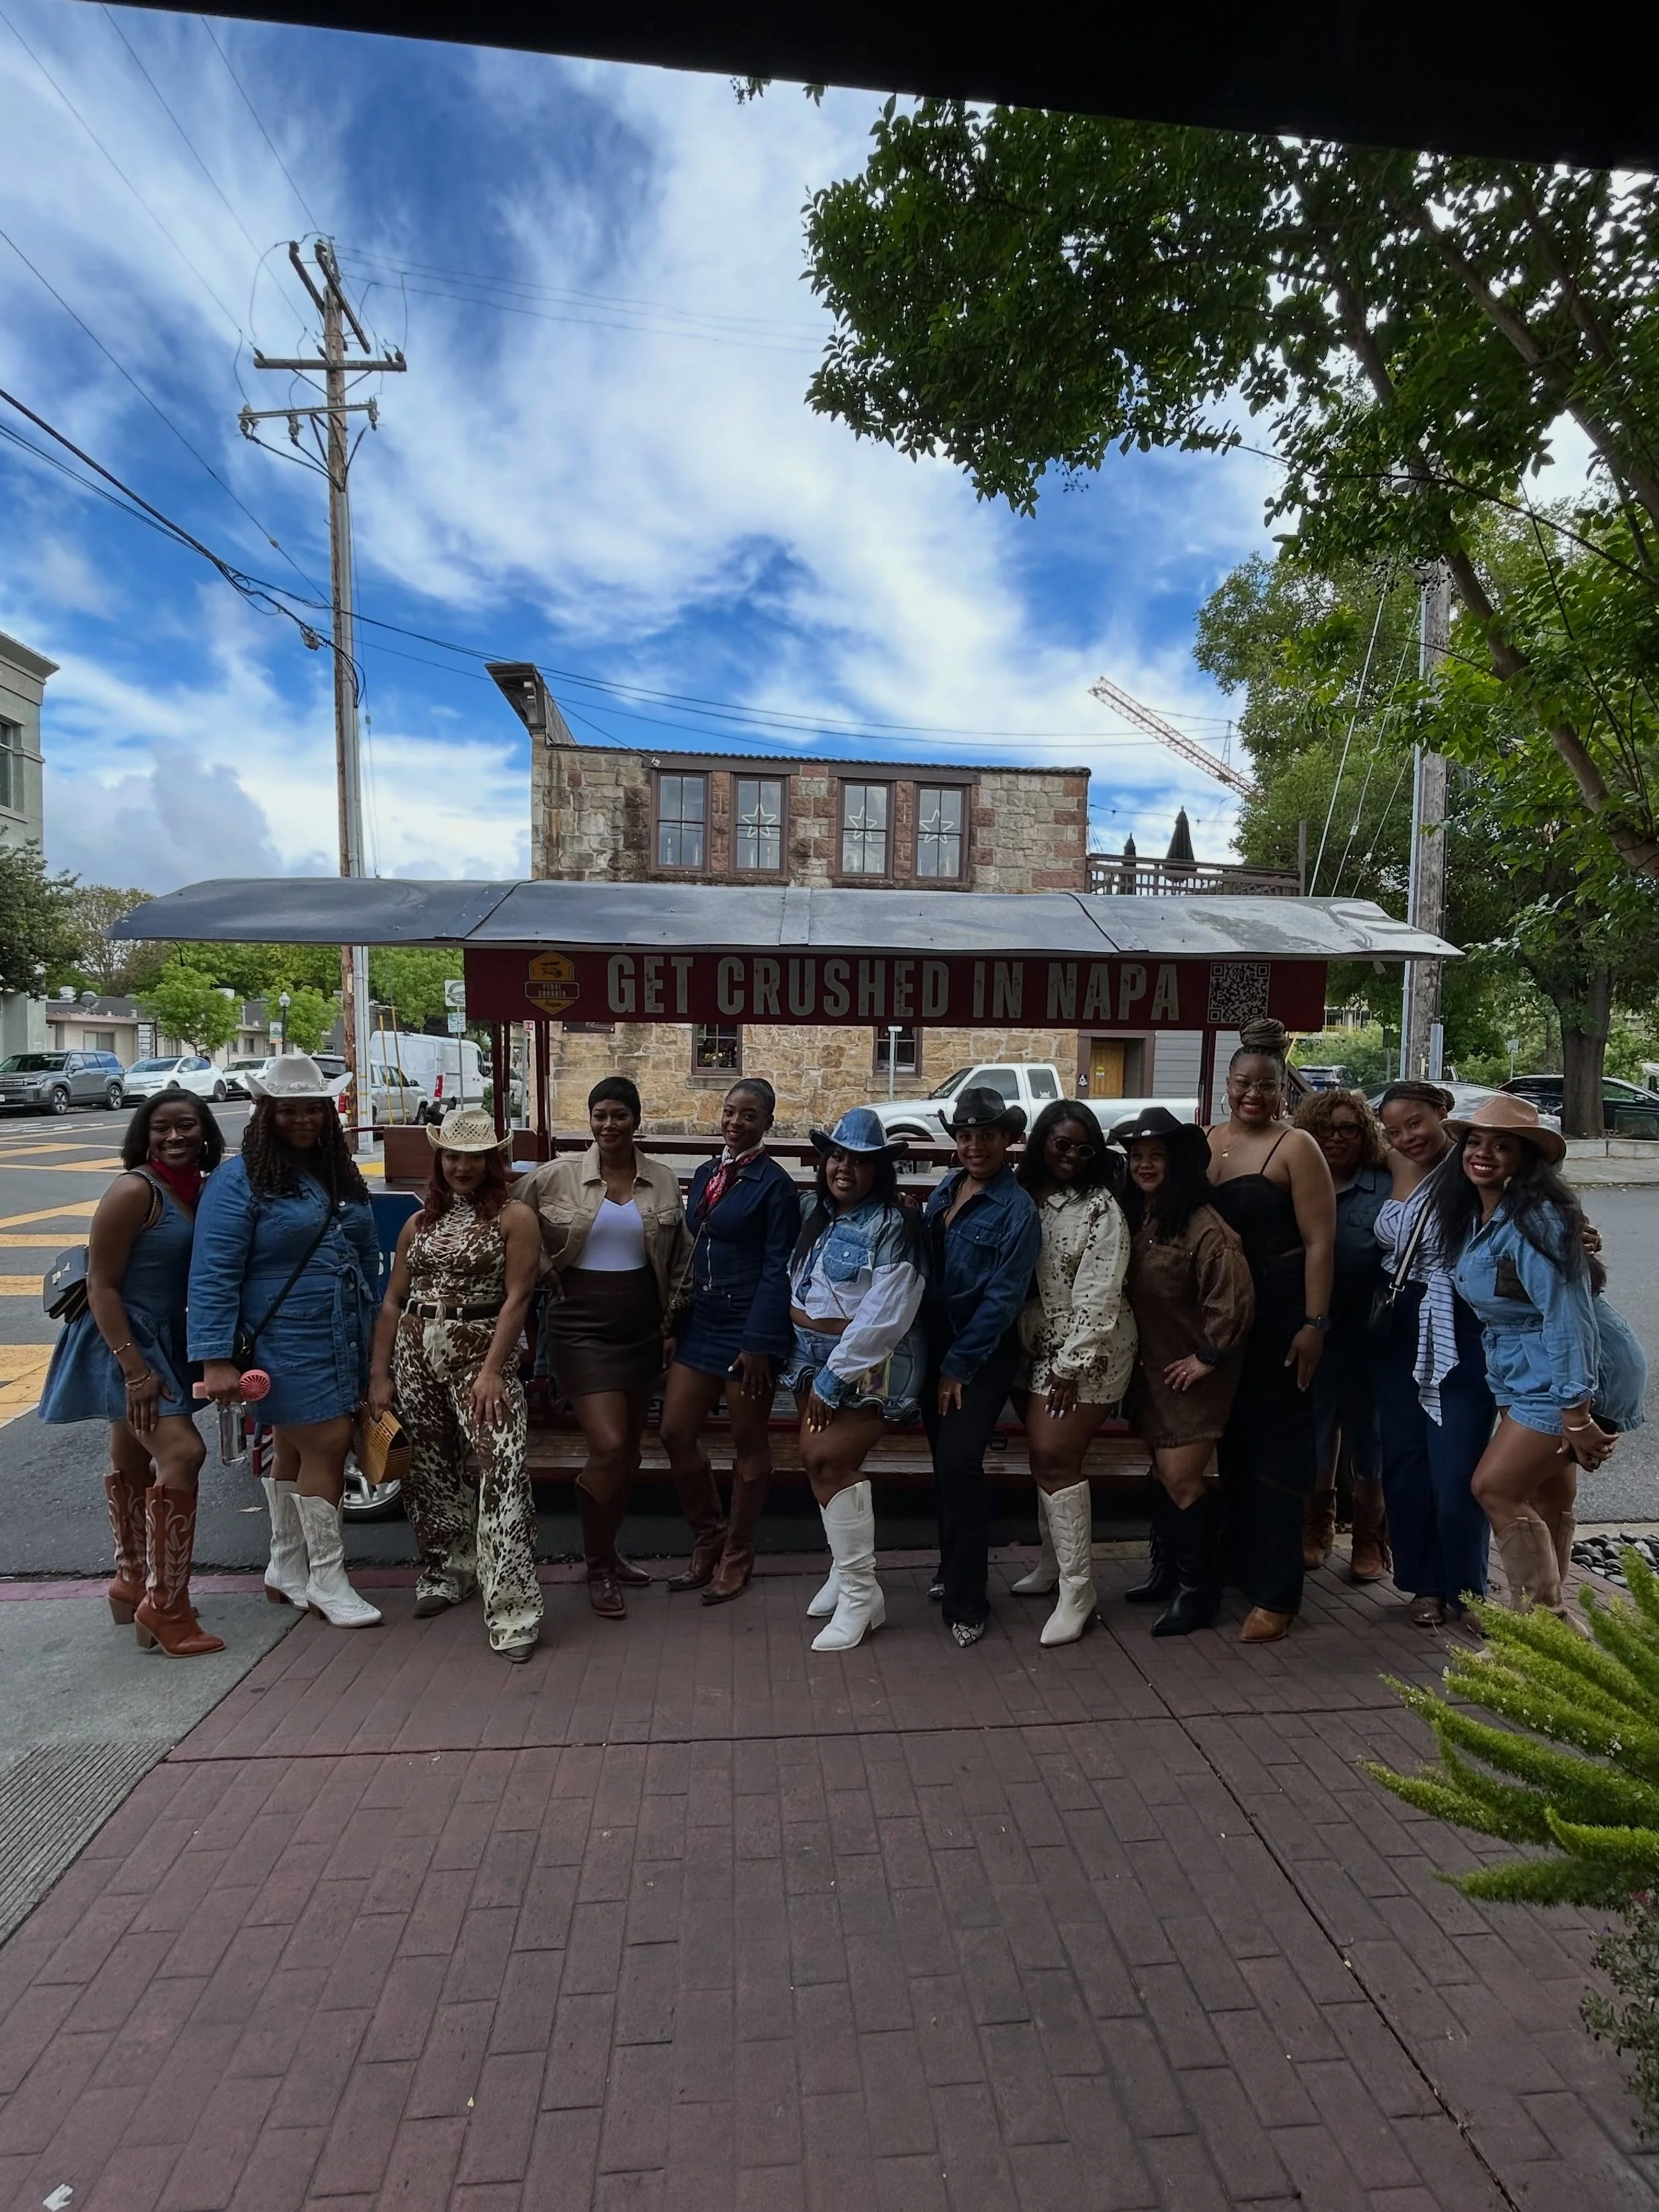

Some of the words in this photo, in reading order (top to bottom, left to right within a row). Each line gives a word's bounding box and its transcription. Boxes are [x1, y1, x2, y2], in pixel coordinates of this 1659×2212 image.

[607, 954, 694, 1015] GET
[717, 956, 950, 1018] CRUSHED
[972, 961, 1023, 1019] IN
[1046, 962, 1180, 1021] NAPA
